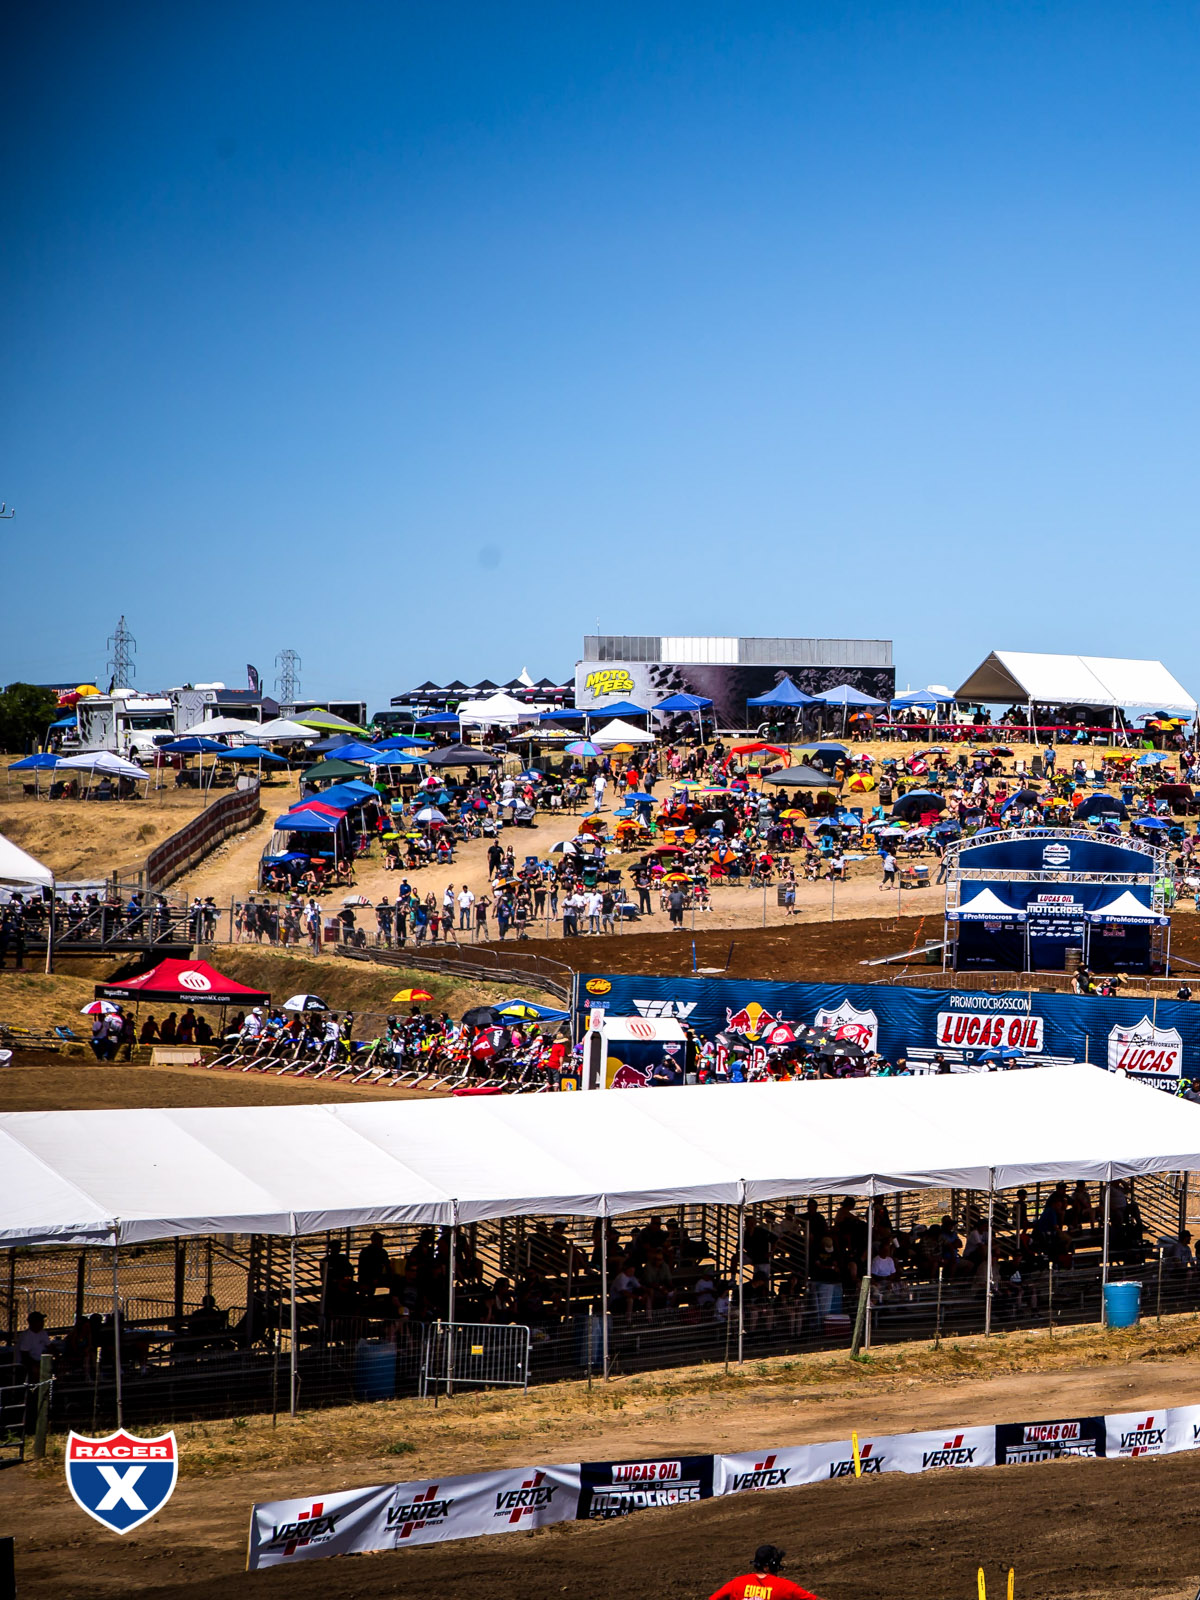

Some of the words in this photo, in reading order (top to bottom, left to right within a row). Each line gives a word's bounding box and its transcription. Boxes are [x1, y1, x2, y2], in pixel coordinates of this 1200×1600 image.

[586, 669, 630, 688] MOTO
[592, 679, 635, 697] TEES
[1026, 905, 1084, 914] MOTOCROSS
[1105, 916, 1155, 924] #ProMotocross
[950, 996, 1031, 1010] PROMOTOCROSS.COM
[942, 1016, 1004, 1046] LUCAS
[1008, 1018, 1038, 1047] OIL
[1117, 1048, 1177, 1072] LUCAS
[1026, 1425, 1060, 1441] LUCAS
[1061, 1424, 1077, 1439] OIL
[1120, 1429, 1166, 1448] VERTEX
[829, 1456, 885, 1478] VERTEX
[922, 1447, 977, 1468] VERTEX
[615, 1465, 656, 1482] LUCAS
[659, 1463, 678, 1479] OIL
[733, 1467, 791, 1490] VERTEX
[496, 1486, 559, 1509] VERTEX
[590, 1488, 700, 1510] MOTOCROSS
[387, 1498, 454, 1524] VERTEX
[271, 1515, 340, 1542] VERTEX
